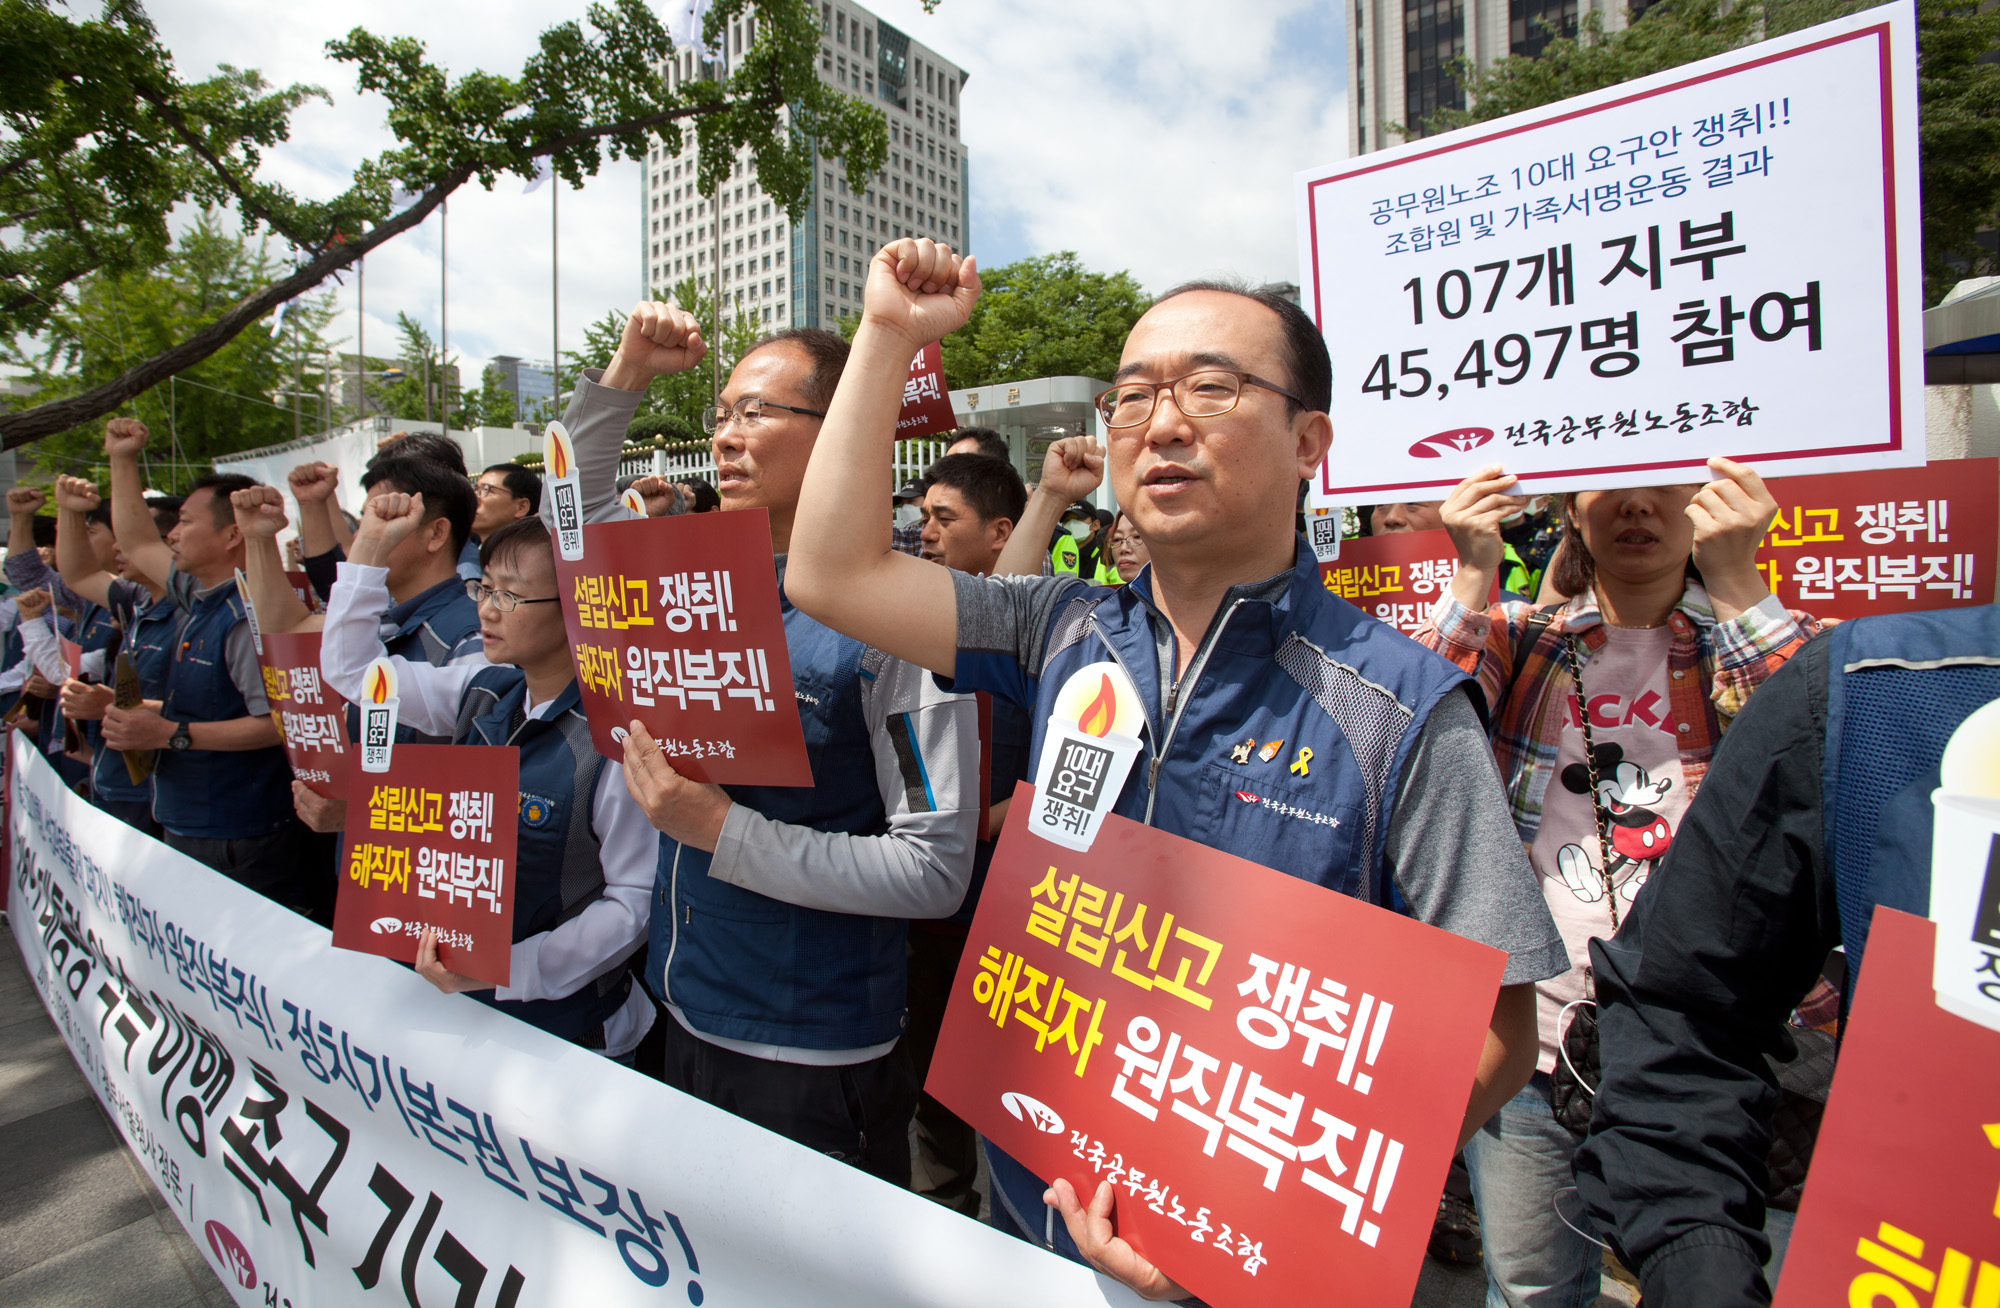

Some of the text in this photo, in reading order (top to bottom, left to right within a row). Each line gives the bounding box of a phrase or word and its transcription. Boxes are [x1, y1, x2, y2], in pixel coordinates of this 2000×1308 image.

[1369, 97, 1791, 226] 공무원노조 10대 요구안 쟁취!!
[1385, 145, 1773, 256] 조합원 및 가족서명운동 결과
[1403, 210, 1747, 325] 107개 지부
[1362, 281, 1823, 401] 45,497명 참여
[1505, 395, 1760, 449] 전국공무원노동조합
[557, 486, 573, 507] 10대
[560, 508, 575, 527] 요구
[562, 531, 580, 550] 쟁취!
[1315, 518, 1333, 532] 10대
[1316, 533, 1333, 544] 요구
[1760, 500, 1949, 547] 신고 쟁취!
[1316, 545, 1336, 557] 쟁취!
[1324, 558, 1459, 599] 설립신고 쟁취
[1792, 553, 1975, 600] 원직복직!
[574, 570, 738, 632] 설립신고 쟁취!
[289, 667, 323, 704] 쟁취!
[576, 643, 776, 712] 해직자 원직복직!
[282, 710, 344, 753] 원직복직!
[368, 728, 386, 745] 요구
[370, 711, 388, 728] 10대
[367, 748, 387, 764] 쟁취!
[1063, 743, 1108, 776] 10대
[1054, 768, 1099, 800] 요구
[368, 785, 443, 833] 설립신고
[448, 790, 494, 843] 쟁취!
[1042, 799, 1090, 838] 쟁취!
[349, 843, 504, 914] 해직자 원직복직!
[1024, 865, 1394, 1095] 설립신고 쟁취!
[113, 881, 169, 972] 해직자
[164, 921, 282, 1054] 원직복직!
[281, 998, 528, 1200] 정치기본권
[520, 1137, 705, 1307] 보장!
[972, 944, 1405, 1247] 해직자 원직복직!
[148, 990, 236, 1158] 이행
[219, 1056, 351, 1270] 촉구
[158, 1143, 183, 1207] 정문
[1071, 1130, 1268, 1277] 전국공무원노동조합
